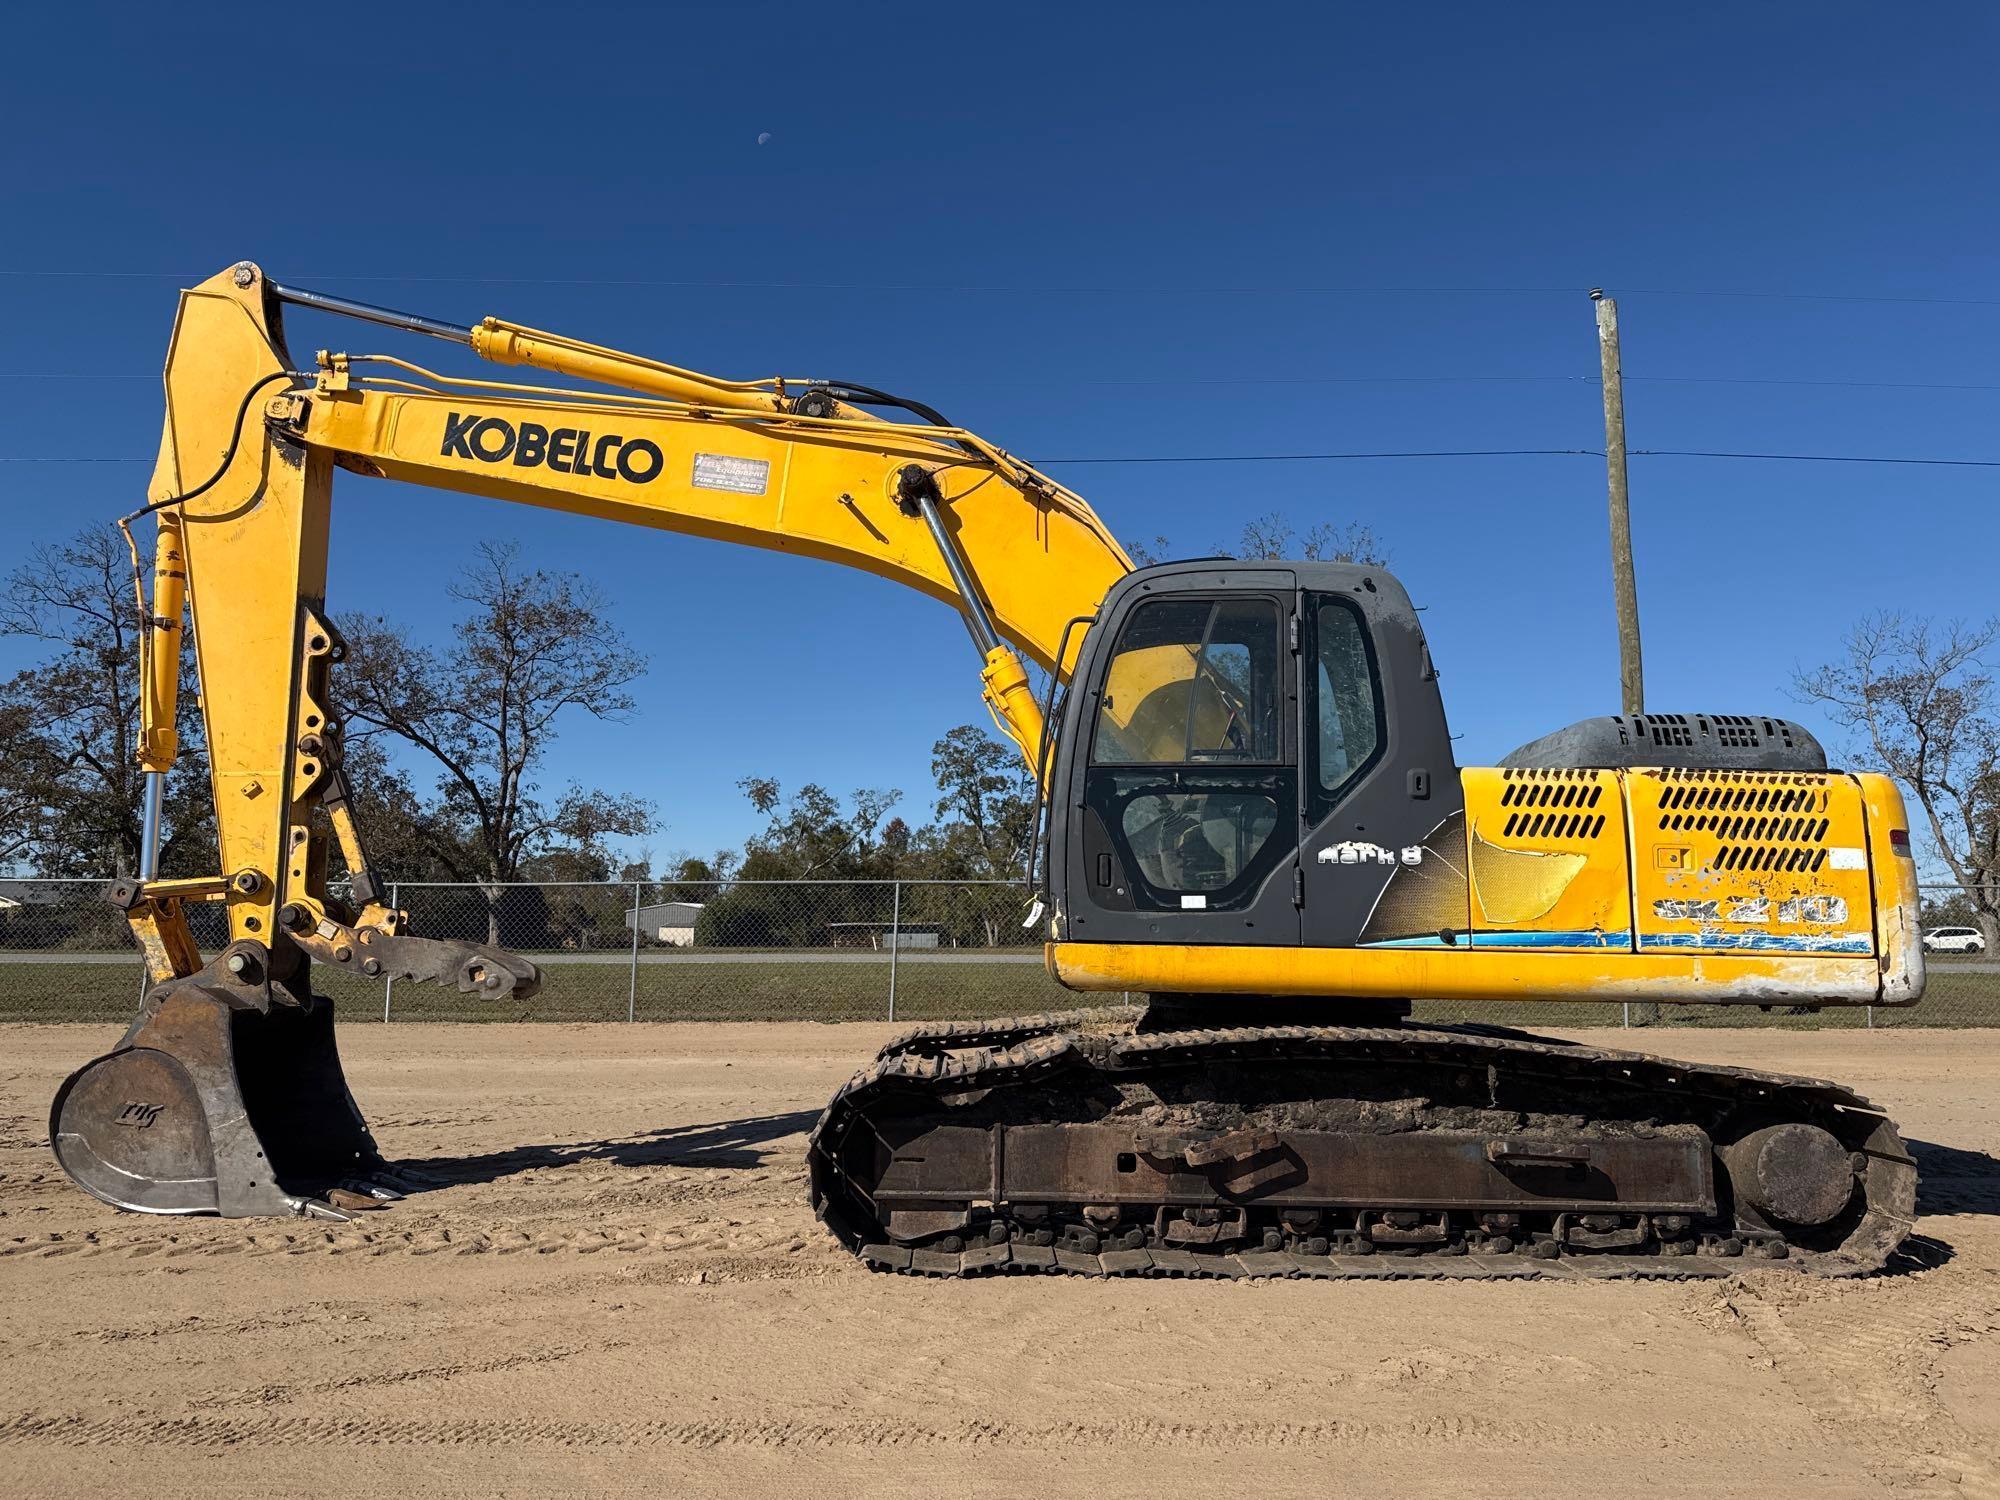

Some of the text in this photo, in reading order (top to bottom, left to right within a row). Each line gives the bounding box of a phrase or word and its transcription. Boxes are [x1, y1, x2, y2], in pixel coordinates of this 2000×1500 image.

[440, 411, 664, 484] KOBELCO
[1401, 845, 1422, 865] 8
[1652, 894, 1849, 924] SK210
